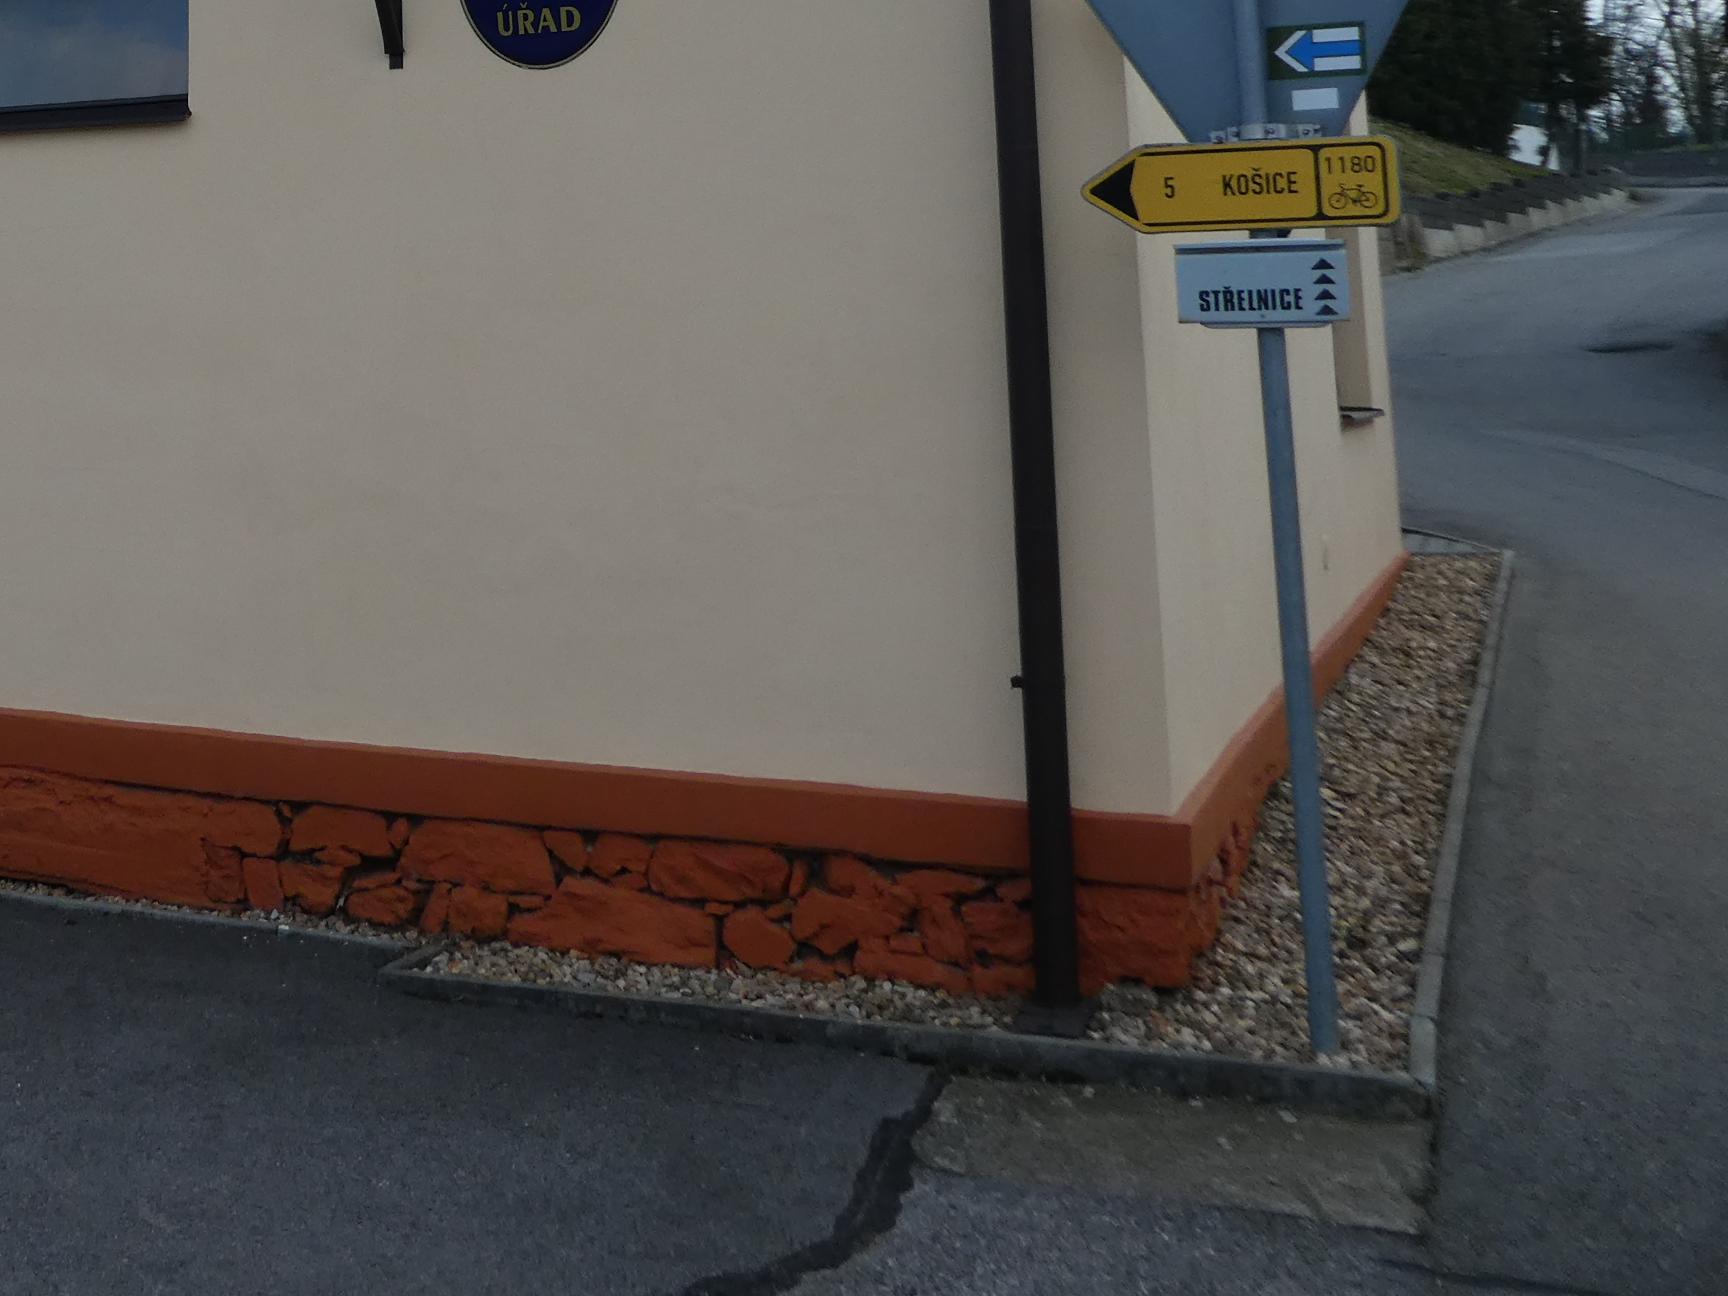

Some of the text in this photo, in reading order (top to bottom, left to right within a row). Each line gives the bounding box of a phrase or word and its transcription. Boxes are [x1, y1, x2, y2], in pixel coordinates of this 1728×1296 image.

[496, 2, 582, 37] ÚŘAD
[1324, 155, 1377, 174] 1180
[1164, 167, 1299, 199] 5 KOŠICE
[1199, 286, 1303, 312] STŘELNICE
